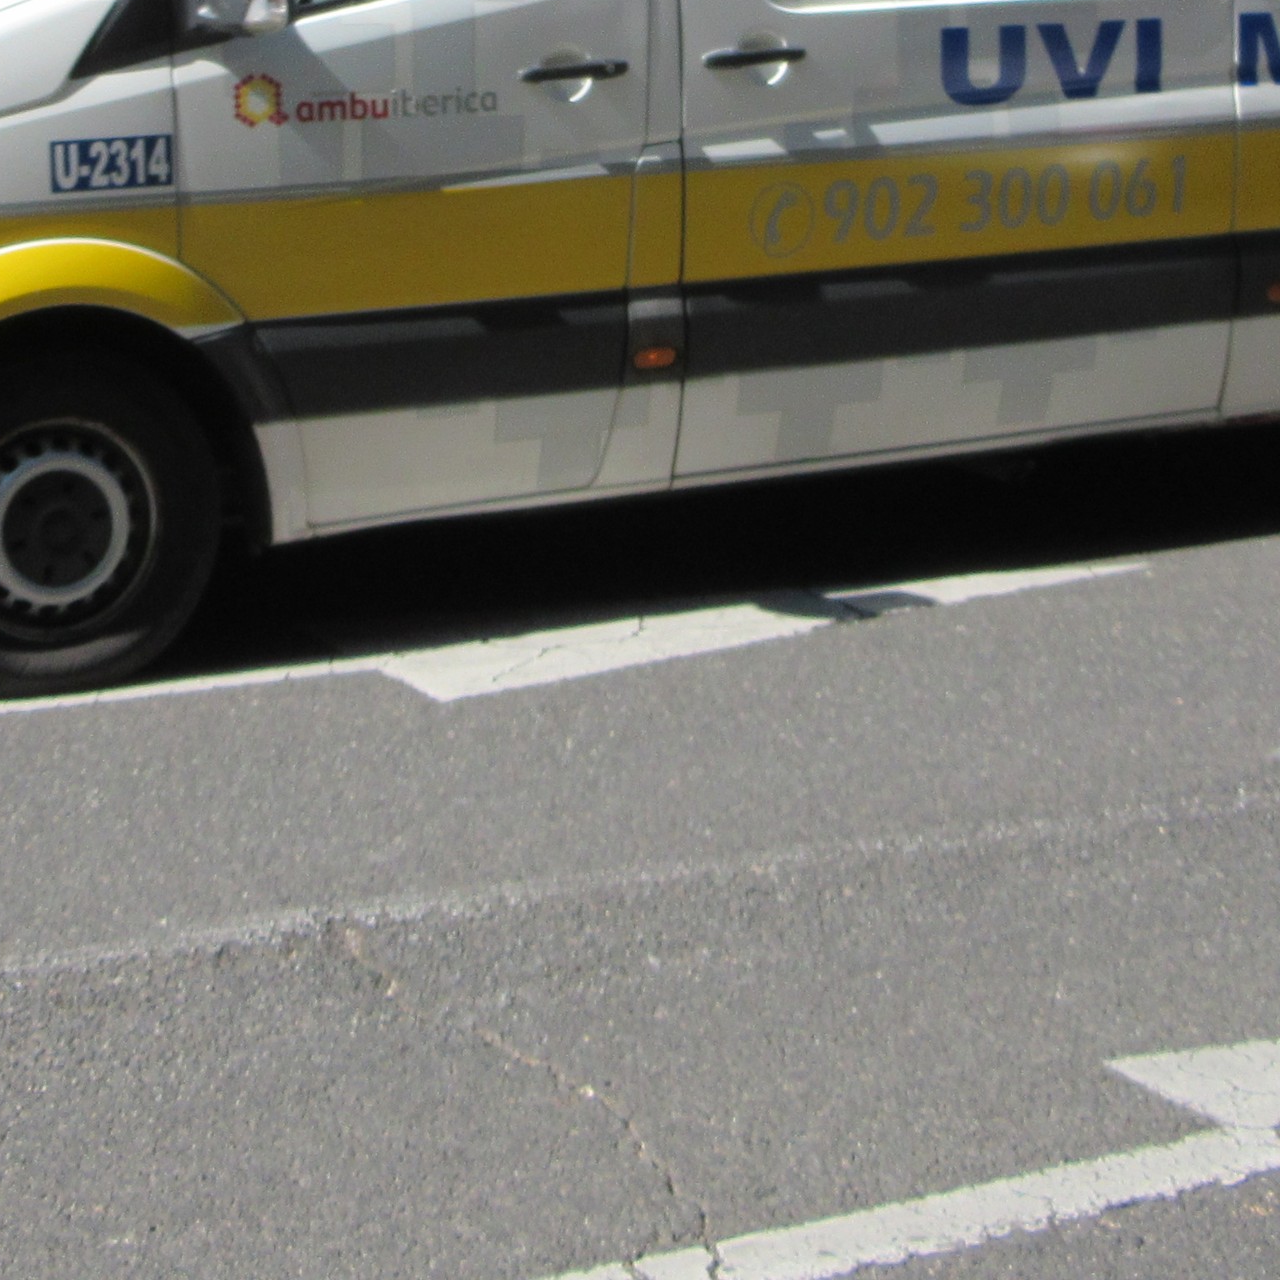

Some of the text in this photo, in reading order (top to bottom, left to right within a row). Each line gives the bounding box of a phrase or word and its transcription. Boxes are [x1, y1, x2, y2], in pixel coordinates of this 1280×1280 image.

[938, 17, 1165, 107] UVI
[53, 136, 170, 190] U-2314
[824, 154, 1188, 244] 902 300 061
